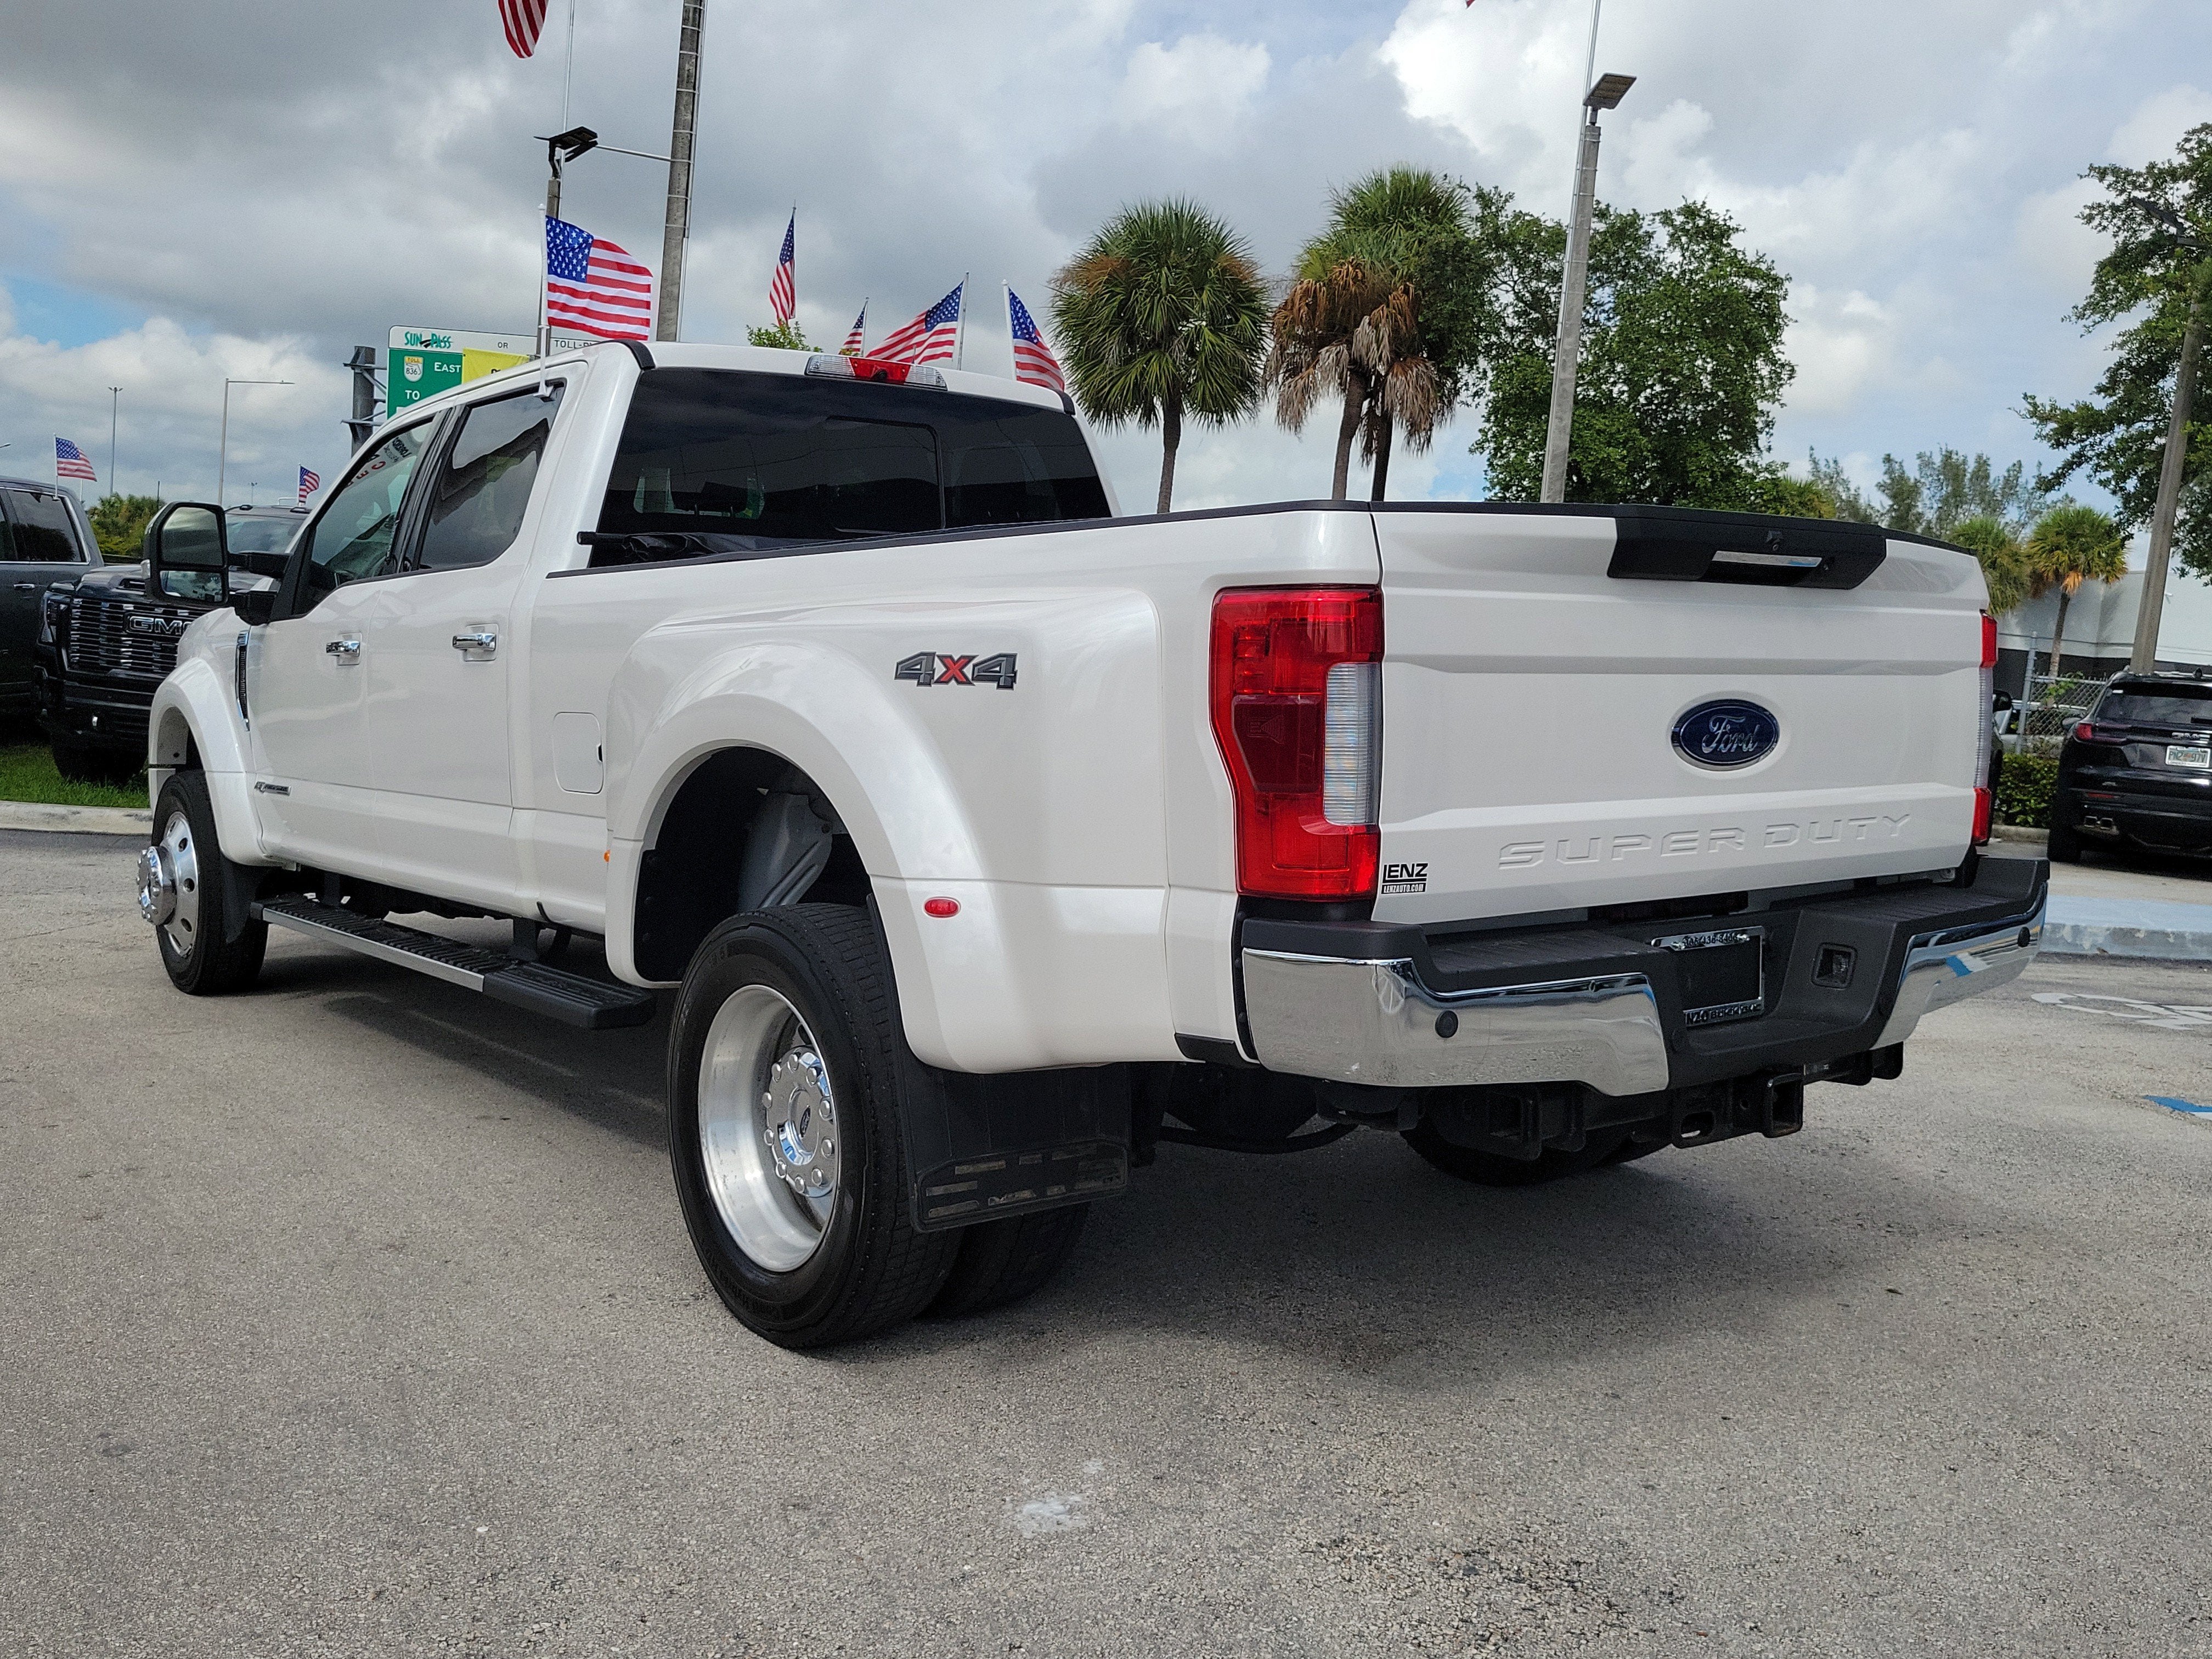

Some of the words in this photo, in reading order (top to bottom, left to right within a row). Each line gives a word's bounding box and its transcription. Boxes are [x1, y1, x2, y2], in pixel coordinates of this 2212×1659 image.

[434, 362, 461, 373] EAST
[405, 390, 420, 400] TO
[129, 616, 192, 635] GM
[1701, 714, 1760, 754] Ford
[1498, 827, 1745, 870] SUPER
[1764, 814, 1911, 848] DUTY
[1383, 863, 1428, 883] LENZ
[1383, 884, 1424, 893] LENZAUTO.COM
